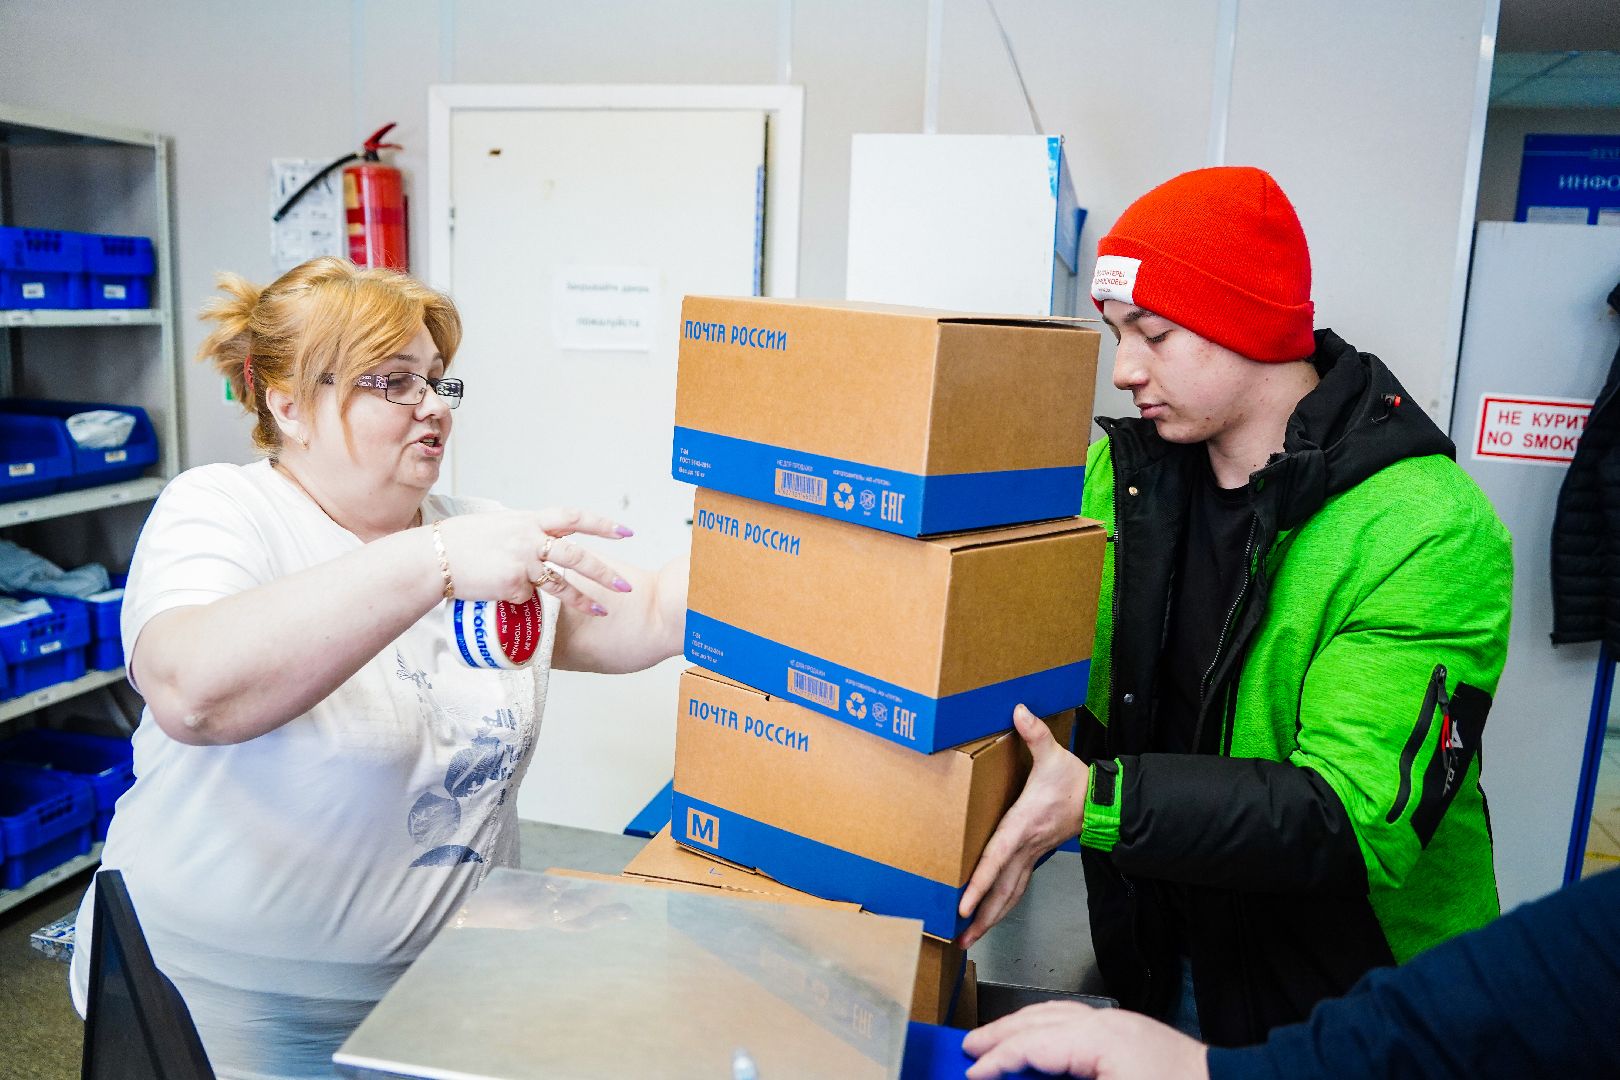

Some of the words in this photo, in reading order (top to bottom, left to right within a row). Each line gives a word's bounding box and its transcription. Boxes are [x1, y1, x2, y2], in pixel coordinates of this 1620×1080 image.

[1559, 174, 1620, 191] ИНФО
[684, 320, 726, 344] ПОЧТА
[731, 325, 787, 351] РОССИИ
[1498, 409, 1522, 426] НЕ
[1487, 431, 1513, 446] NO
[1523, 433, 1578, 452] SMOK
[697, 509, 739, 539] ПОЧТА
[744, 522, 801, 556] РОССИИ
[689, 698, 738, 730] ПОЧТА
[745, 714, 809, 753] РОССИИ
[692, 813, 714, 843] M
